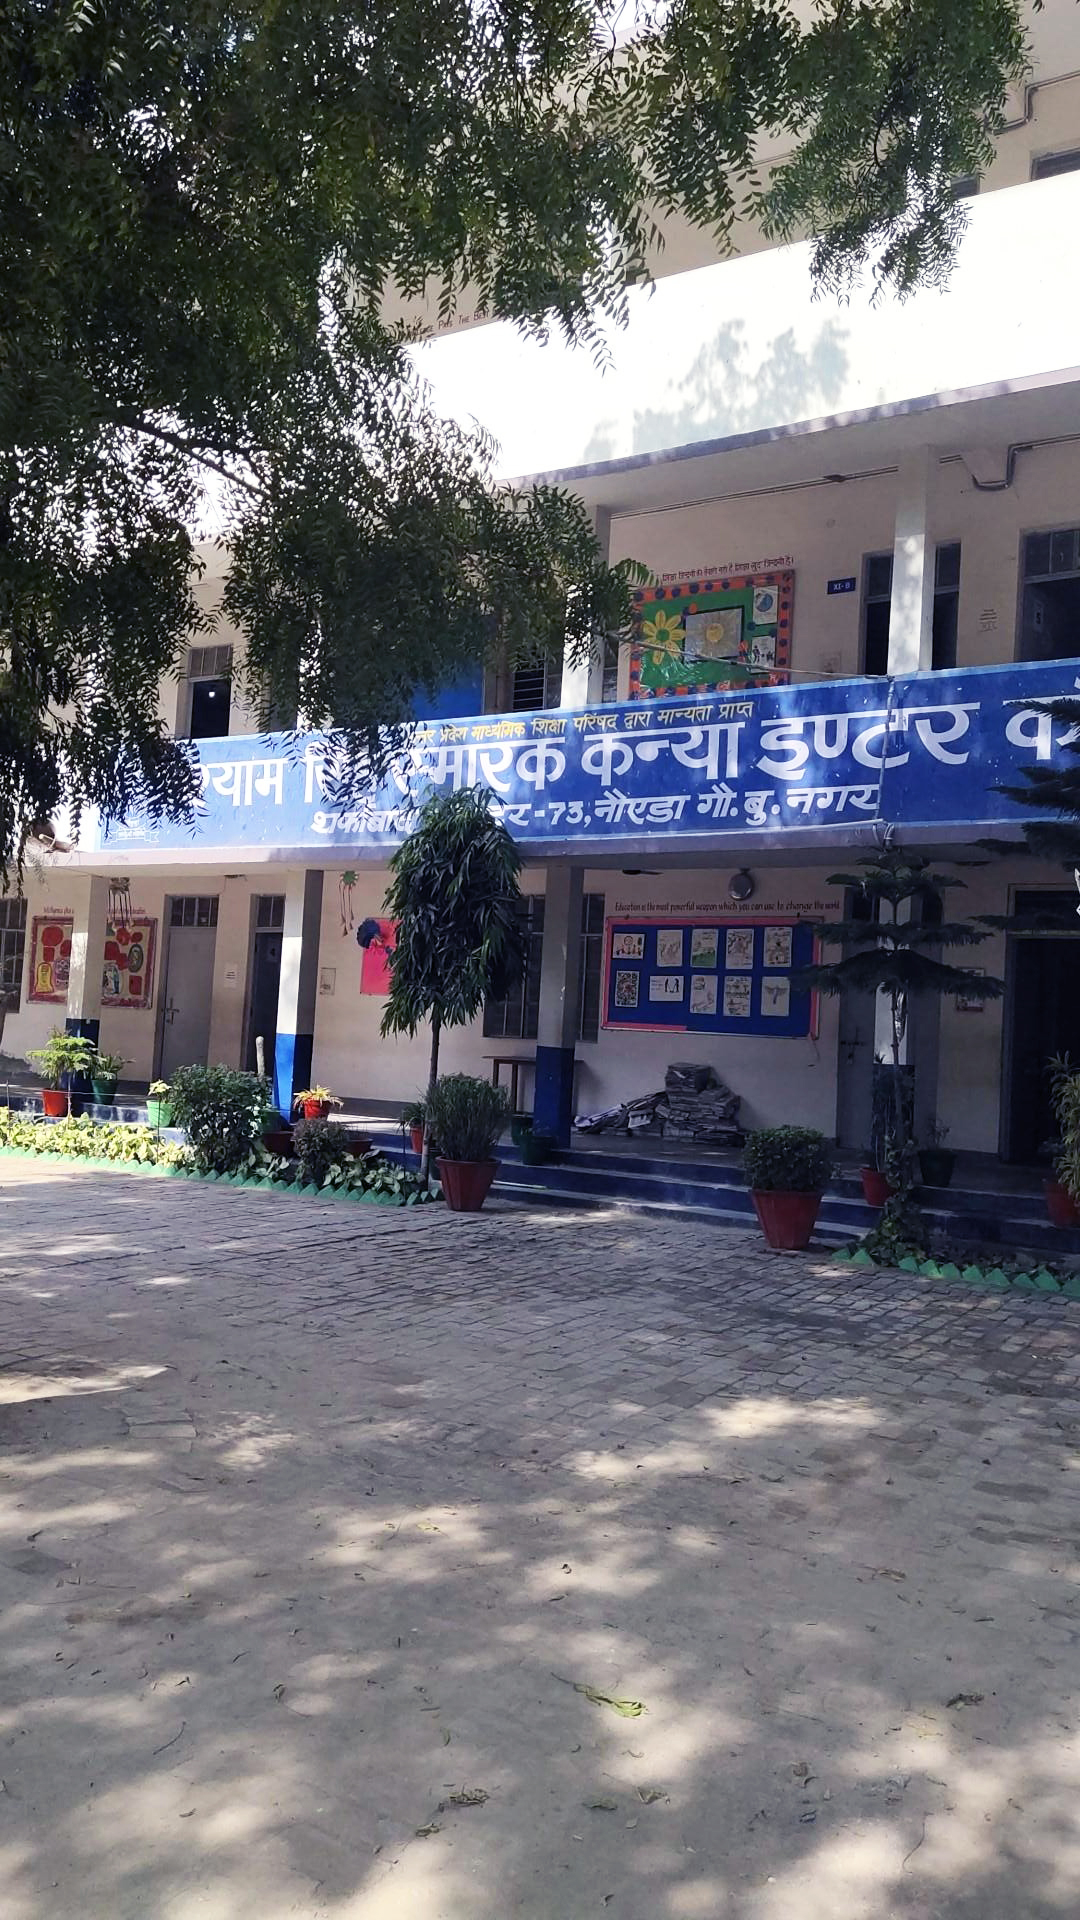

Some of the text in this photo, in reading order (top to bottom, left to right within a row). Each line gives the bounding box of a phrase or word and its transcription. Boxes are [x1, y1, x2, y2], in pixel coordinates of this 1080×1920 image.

[623, 711, 654, 730] द्वारा
[657, 705, 714, 726] मान्यता
[718, 701, 754, 721] प्राप्त
[581, 721, 746, 787] कन्या
[756, 702, 981, 781] इण्टर
